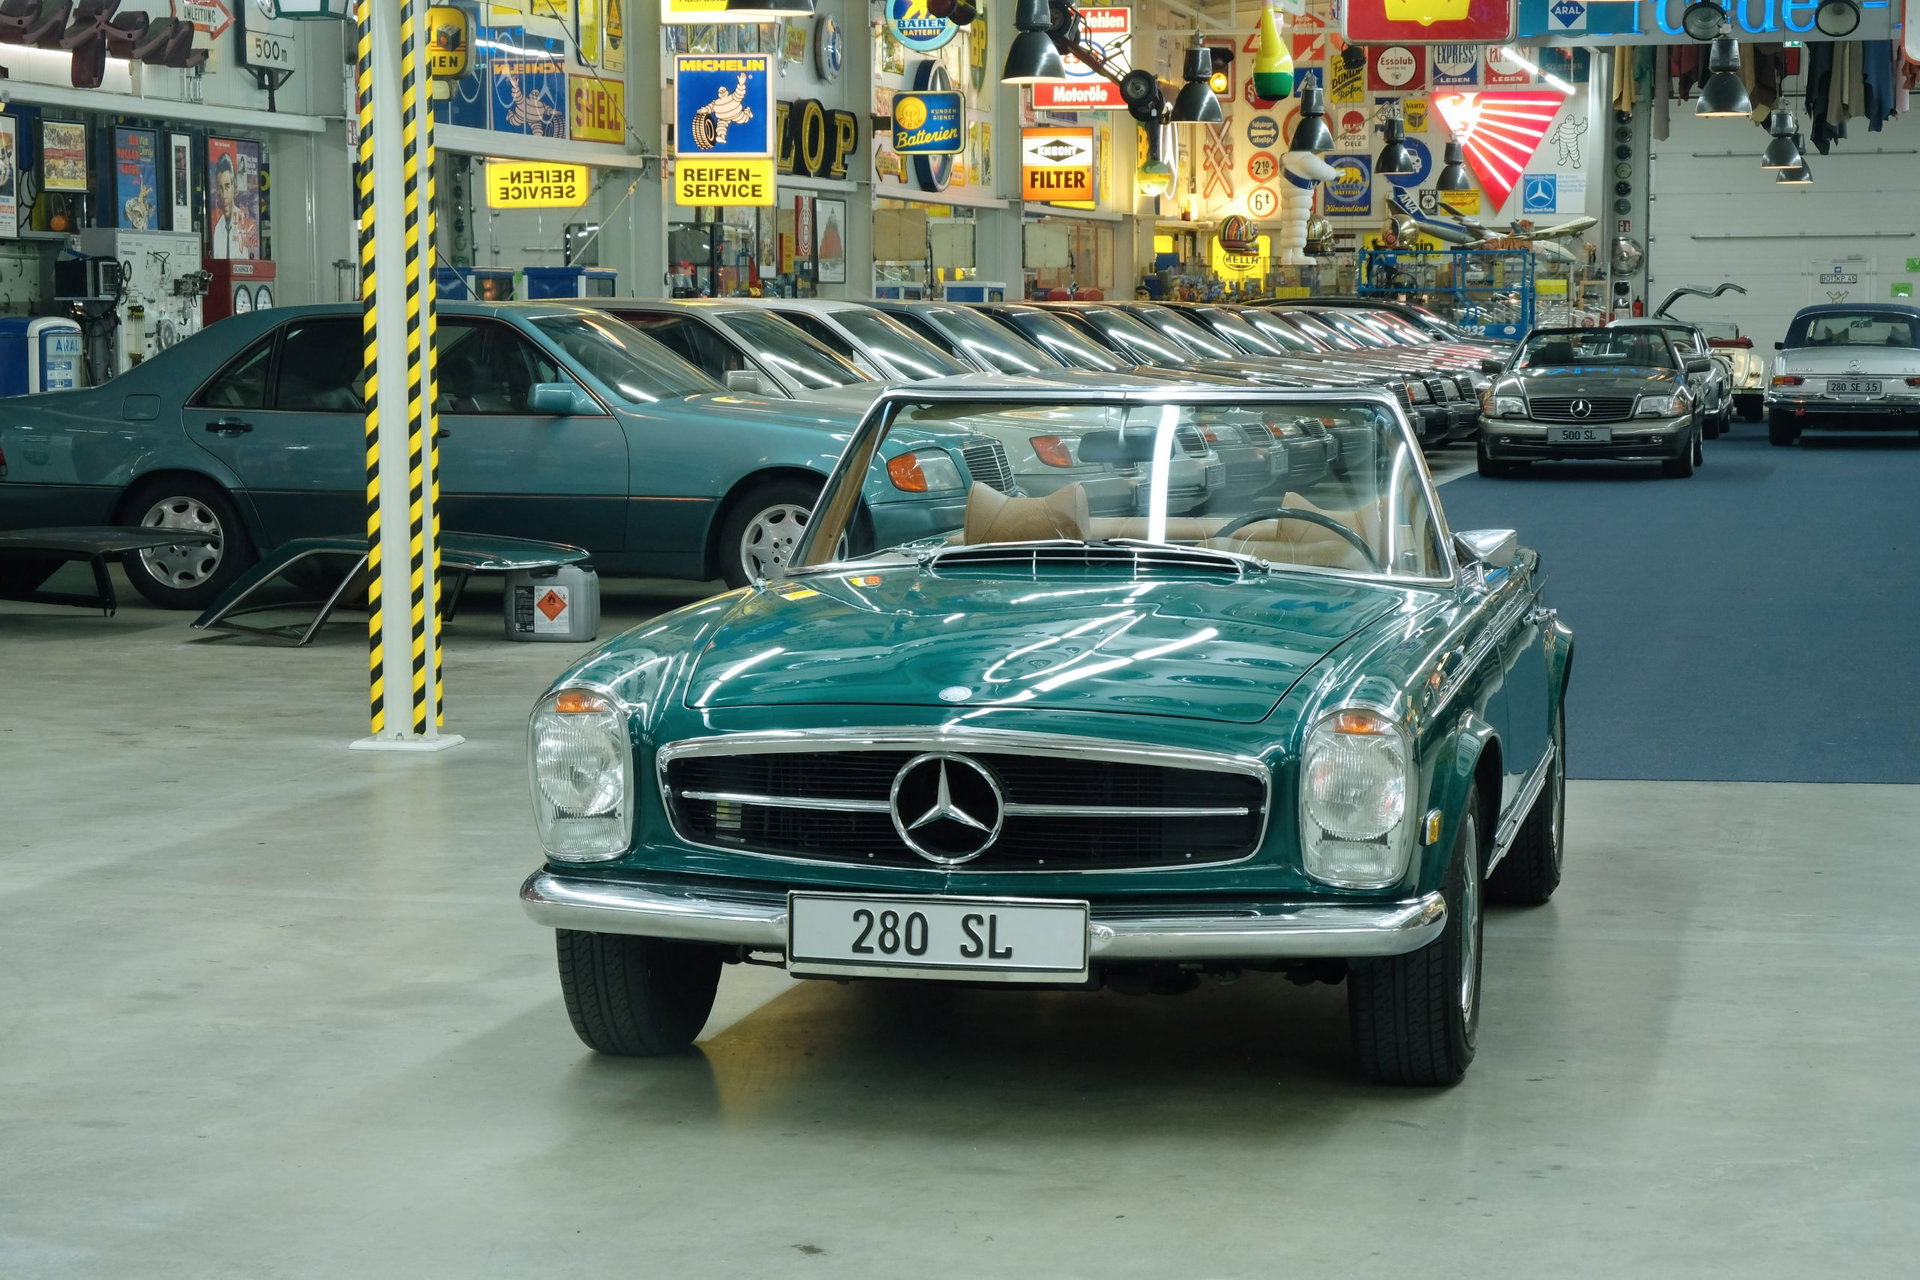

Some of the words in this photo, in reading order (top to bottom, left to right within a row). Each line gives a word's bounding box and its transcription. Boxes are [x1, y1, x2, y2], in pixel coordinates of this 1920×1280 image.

[1554, 6, 1581, 15] ARAL
[903, 28, 941, 36] BATTERIE
[255, 38, 280, 60] 500
[281, 49, 288, 62] m
[1437, 45, 1474, 64] EXPRESS
[679, 60, 765, 72] MICHELIN
[1380, 56, 1413, 66] Essolub
[1053, 85, 1107, 102] Motoröle
[575, 88, 620, 130] SHELL
[895, 126, 958, 149] Batterien
[1037, 146, 1076, 156] KNECHT
[683, 168, 761, 181] REIFEN-
[1030, 170, 1086, 189] FILTER
[683, 184, 763, 198] SERVICE
[1255, 194, 1263, 211] 6
[1265, 193, 1270, 204] t
[1225, 257, 1258, 265] HELLA
[56, 338, 79, 351] ARAL
[1831, 382, 1847, 392] 280
[1851, 383, 1861, 392] SE
[1865, 383, 1878, 392] 3.5
[1562, 430, 1581, 441] 500
[1584, 430, 1597, 441] SL
[851, 908, 929, 957] 280
[960, 912, 1013, 960] SL
